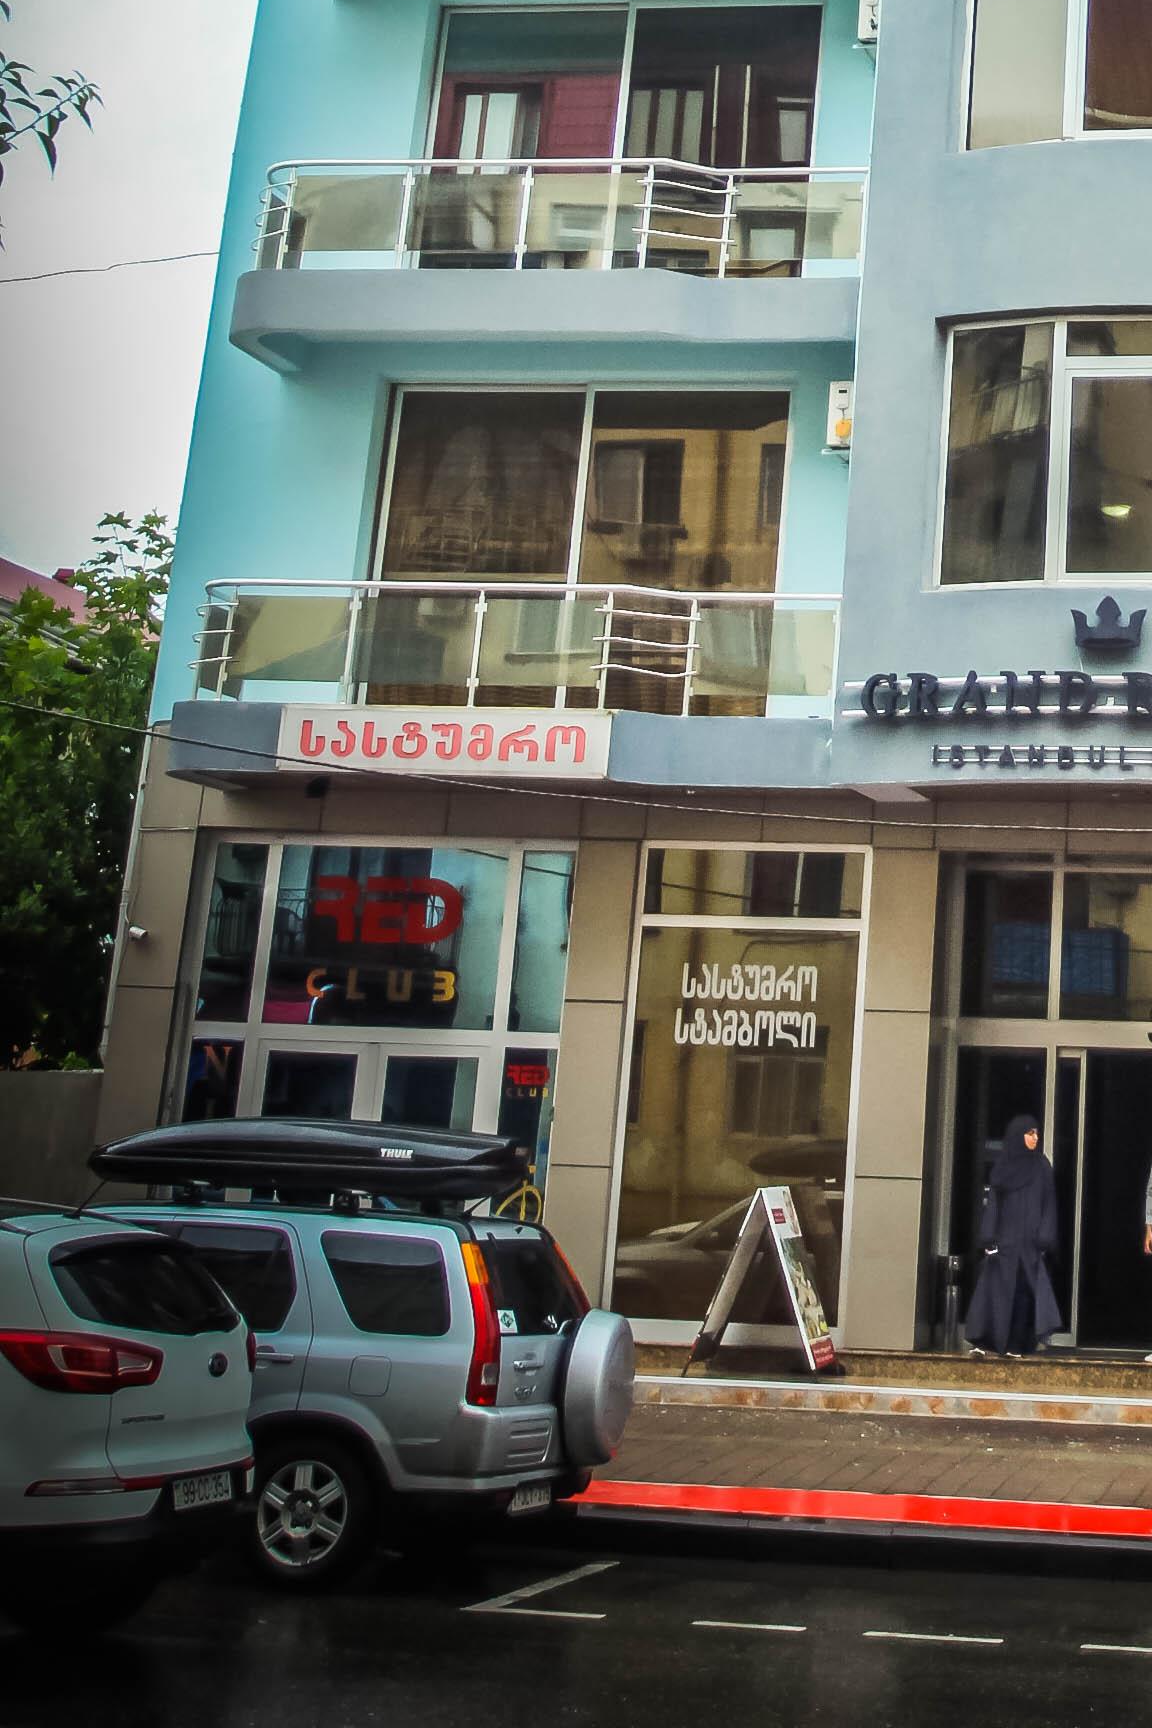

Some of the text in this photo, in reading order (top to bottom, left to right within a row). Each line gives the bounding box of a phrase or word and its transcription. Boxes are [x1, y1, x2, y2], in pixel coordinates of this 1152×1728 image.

[860, 670, 1096, 719] GRAND
[299, 719, 587, 763] სასტუმრო
[931, 743, 1133, 773] ISTANBUL
[314, 874, 464, 944] RED
[305, 966, 457, 1003] CLUB
[681, 962, 818, 1002] სასტუმრო
[674, 1008, 816, 1048] სტამბოლი
[505, 1087, 549, 1098] CLUB
[506, 1064, 550, 1086] RED
[380, 1147, 414, 1159] THULE
